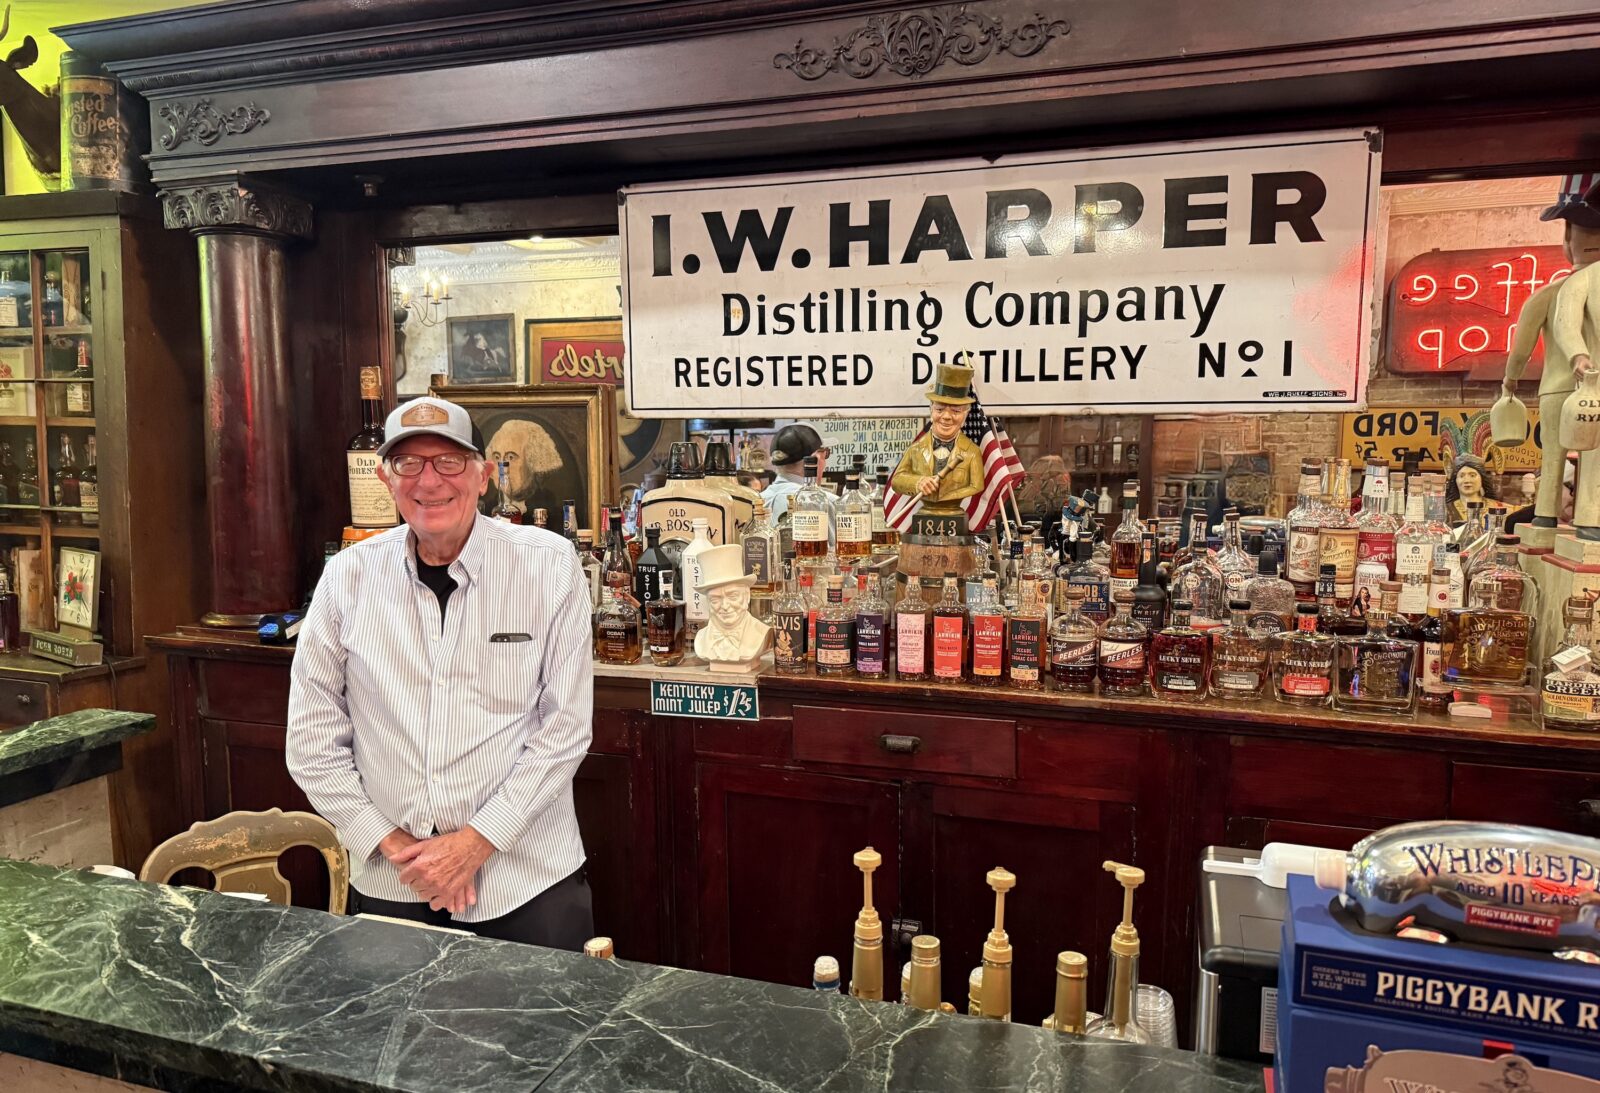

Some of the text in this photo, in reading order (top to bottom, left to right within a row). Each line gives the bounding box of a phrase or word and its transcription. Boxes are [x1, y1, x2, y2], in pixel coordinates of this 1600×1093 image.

[71, 111, 118, 137] Coffee
[722, 281, 1226, 347] Distilling Company
[674, 354, 873, 388] REGISTERED
[348, 465, 377, 475] OREST
[356, 457, 376, 467] OLD
[669, 508, 686, 517] OLD
[667, 520, 717, 539] BOSN
[917, 519, 957, 537] 1843
[1059, 641, 1094, 661] PEERLESS
[1107, 643, 1143, 663] PEERLESS
[660, 683, 715, 699] KENTUCKY
[655, 698, 683, 712] MINT
[688, 700, 721, 715] JULEP
[1455, 882, 1580, 907] AGED 10 YEARS
[1471, 906, 1530, 923] PIGGYBANK
[1532, 917, 1555, 928] RYE
[1334, 975, 1368, 987] WHITE
[1375, 971, 1566, 1025] PIGGYBANK
